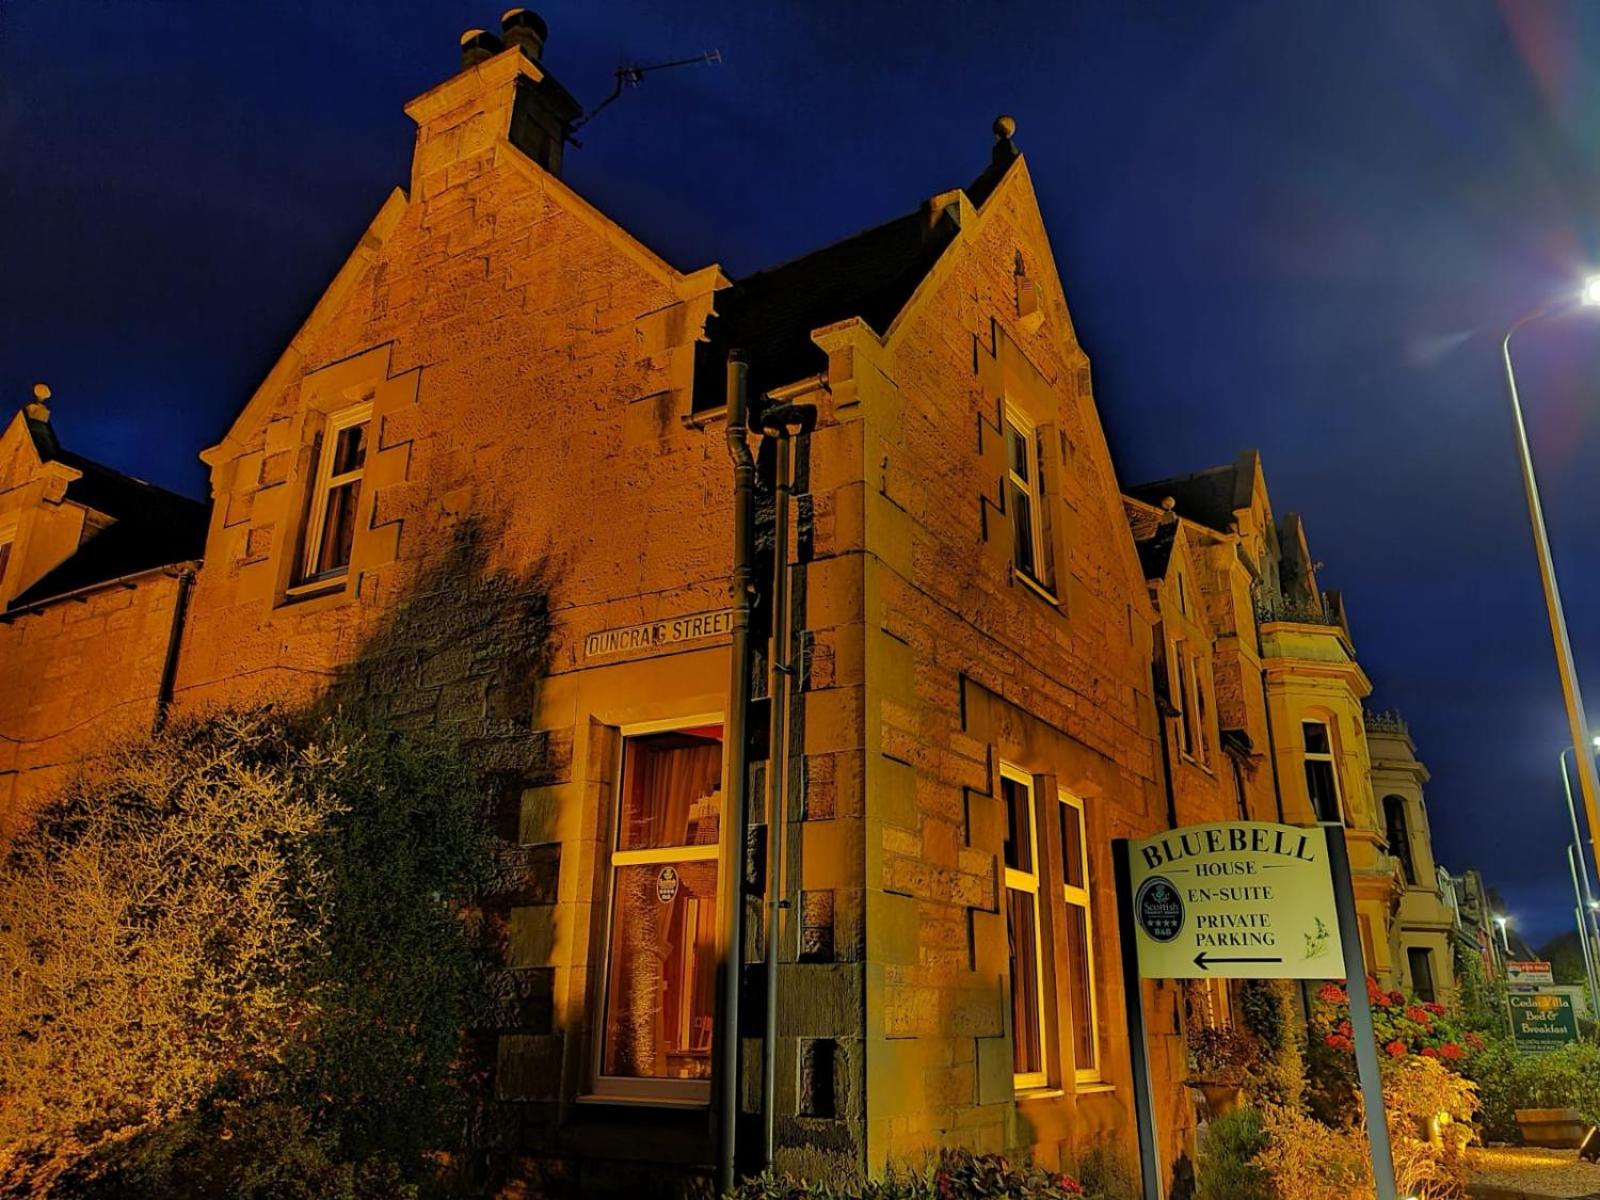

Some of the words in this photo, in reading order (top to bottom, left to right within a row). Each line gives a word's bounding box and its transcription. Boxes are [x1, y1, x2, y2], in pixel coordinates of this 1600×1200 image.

[673, 612, 733, 641] STREET
[1141, 828, 1315, 870] BLUEBELL
[1195, 861, 1257, 877] HOUSE
[1187, 885, 1274, 903] EN-SUITE
[1144, 902, 1179, 912] Scottish
[1196, 913, 1271, 929] PRIVATE
[1196, 932, 1275, 947] PARKING
[1525, 1010, 1546, 1021] Bed
[1547, 1010, 1559, 1021] &
[1521, 1022, 1568, 1034] Breakfast
